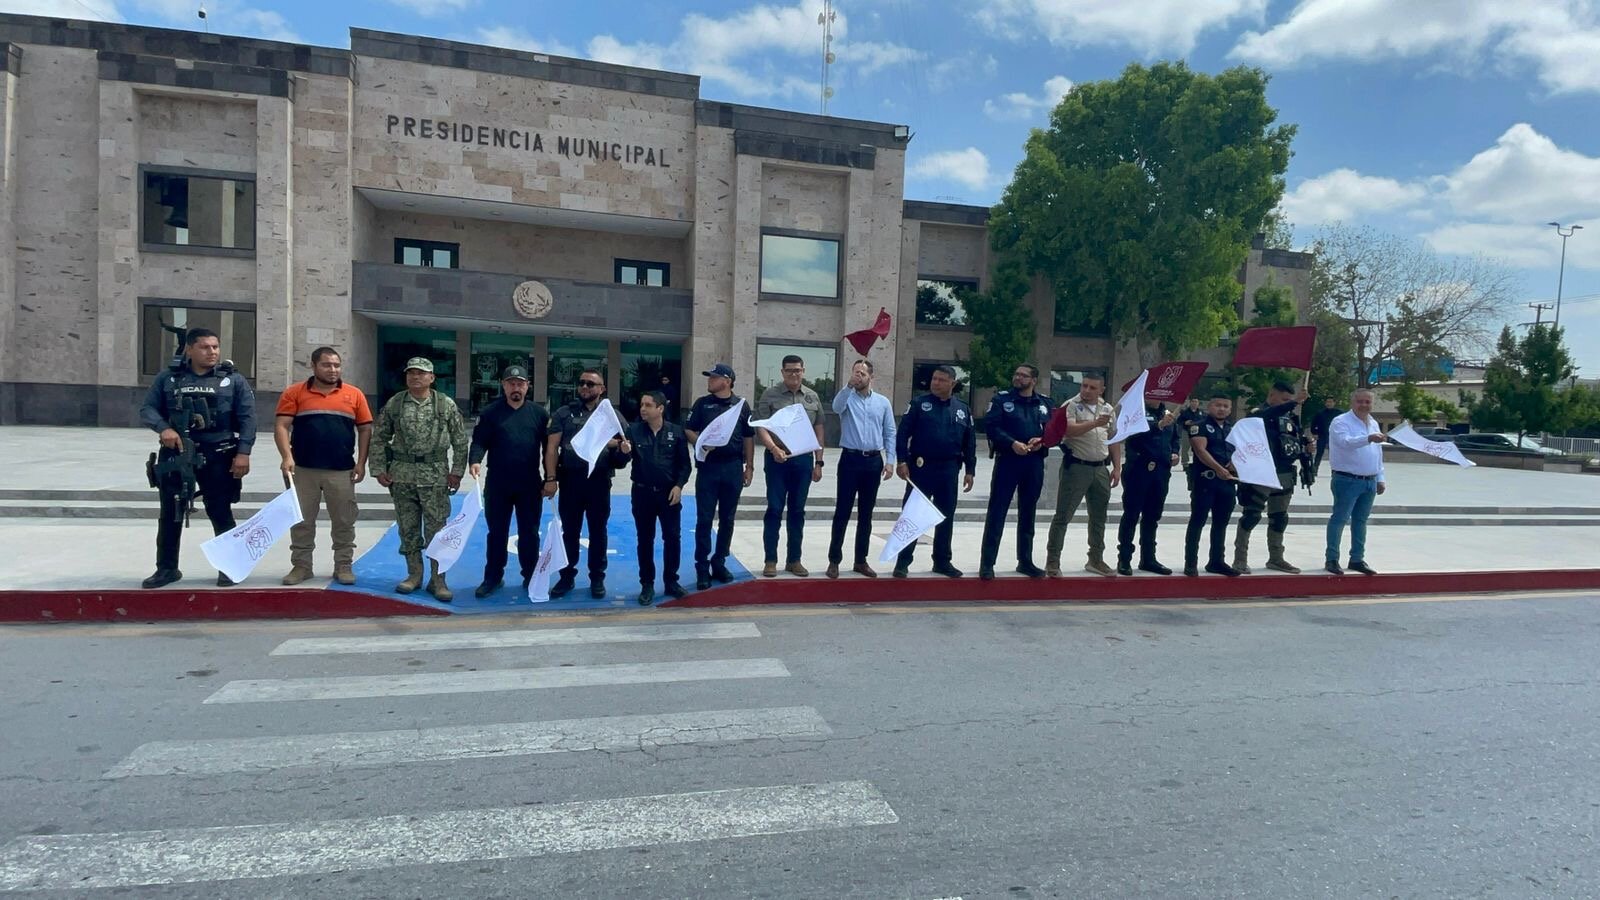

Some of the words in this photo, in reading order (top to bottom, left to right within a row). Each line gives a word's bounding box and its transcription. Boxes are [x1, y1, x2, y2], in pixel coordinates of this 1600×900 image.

[386, 114, 544, 153] PRESIDENCIA
[557, 135, 671, 168] MUNICIPAL
[174, 387, 216, 395] FSCALIA
